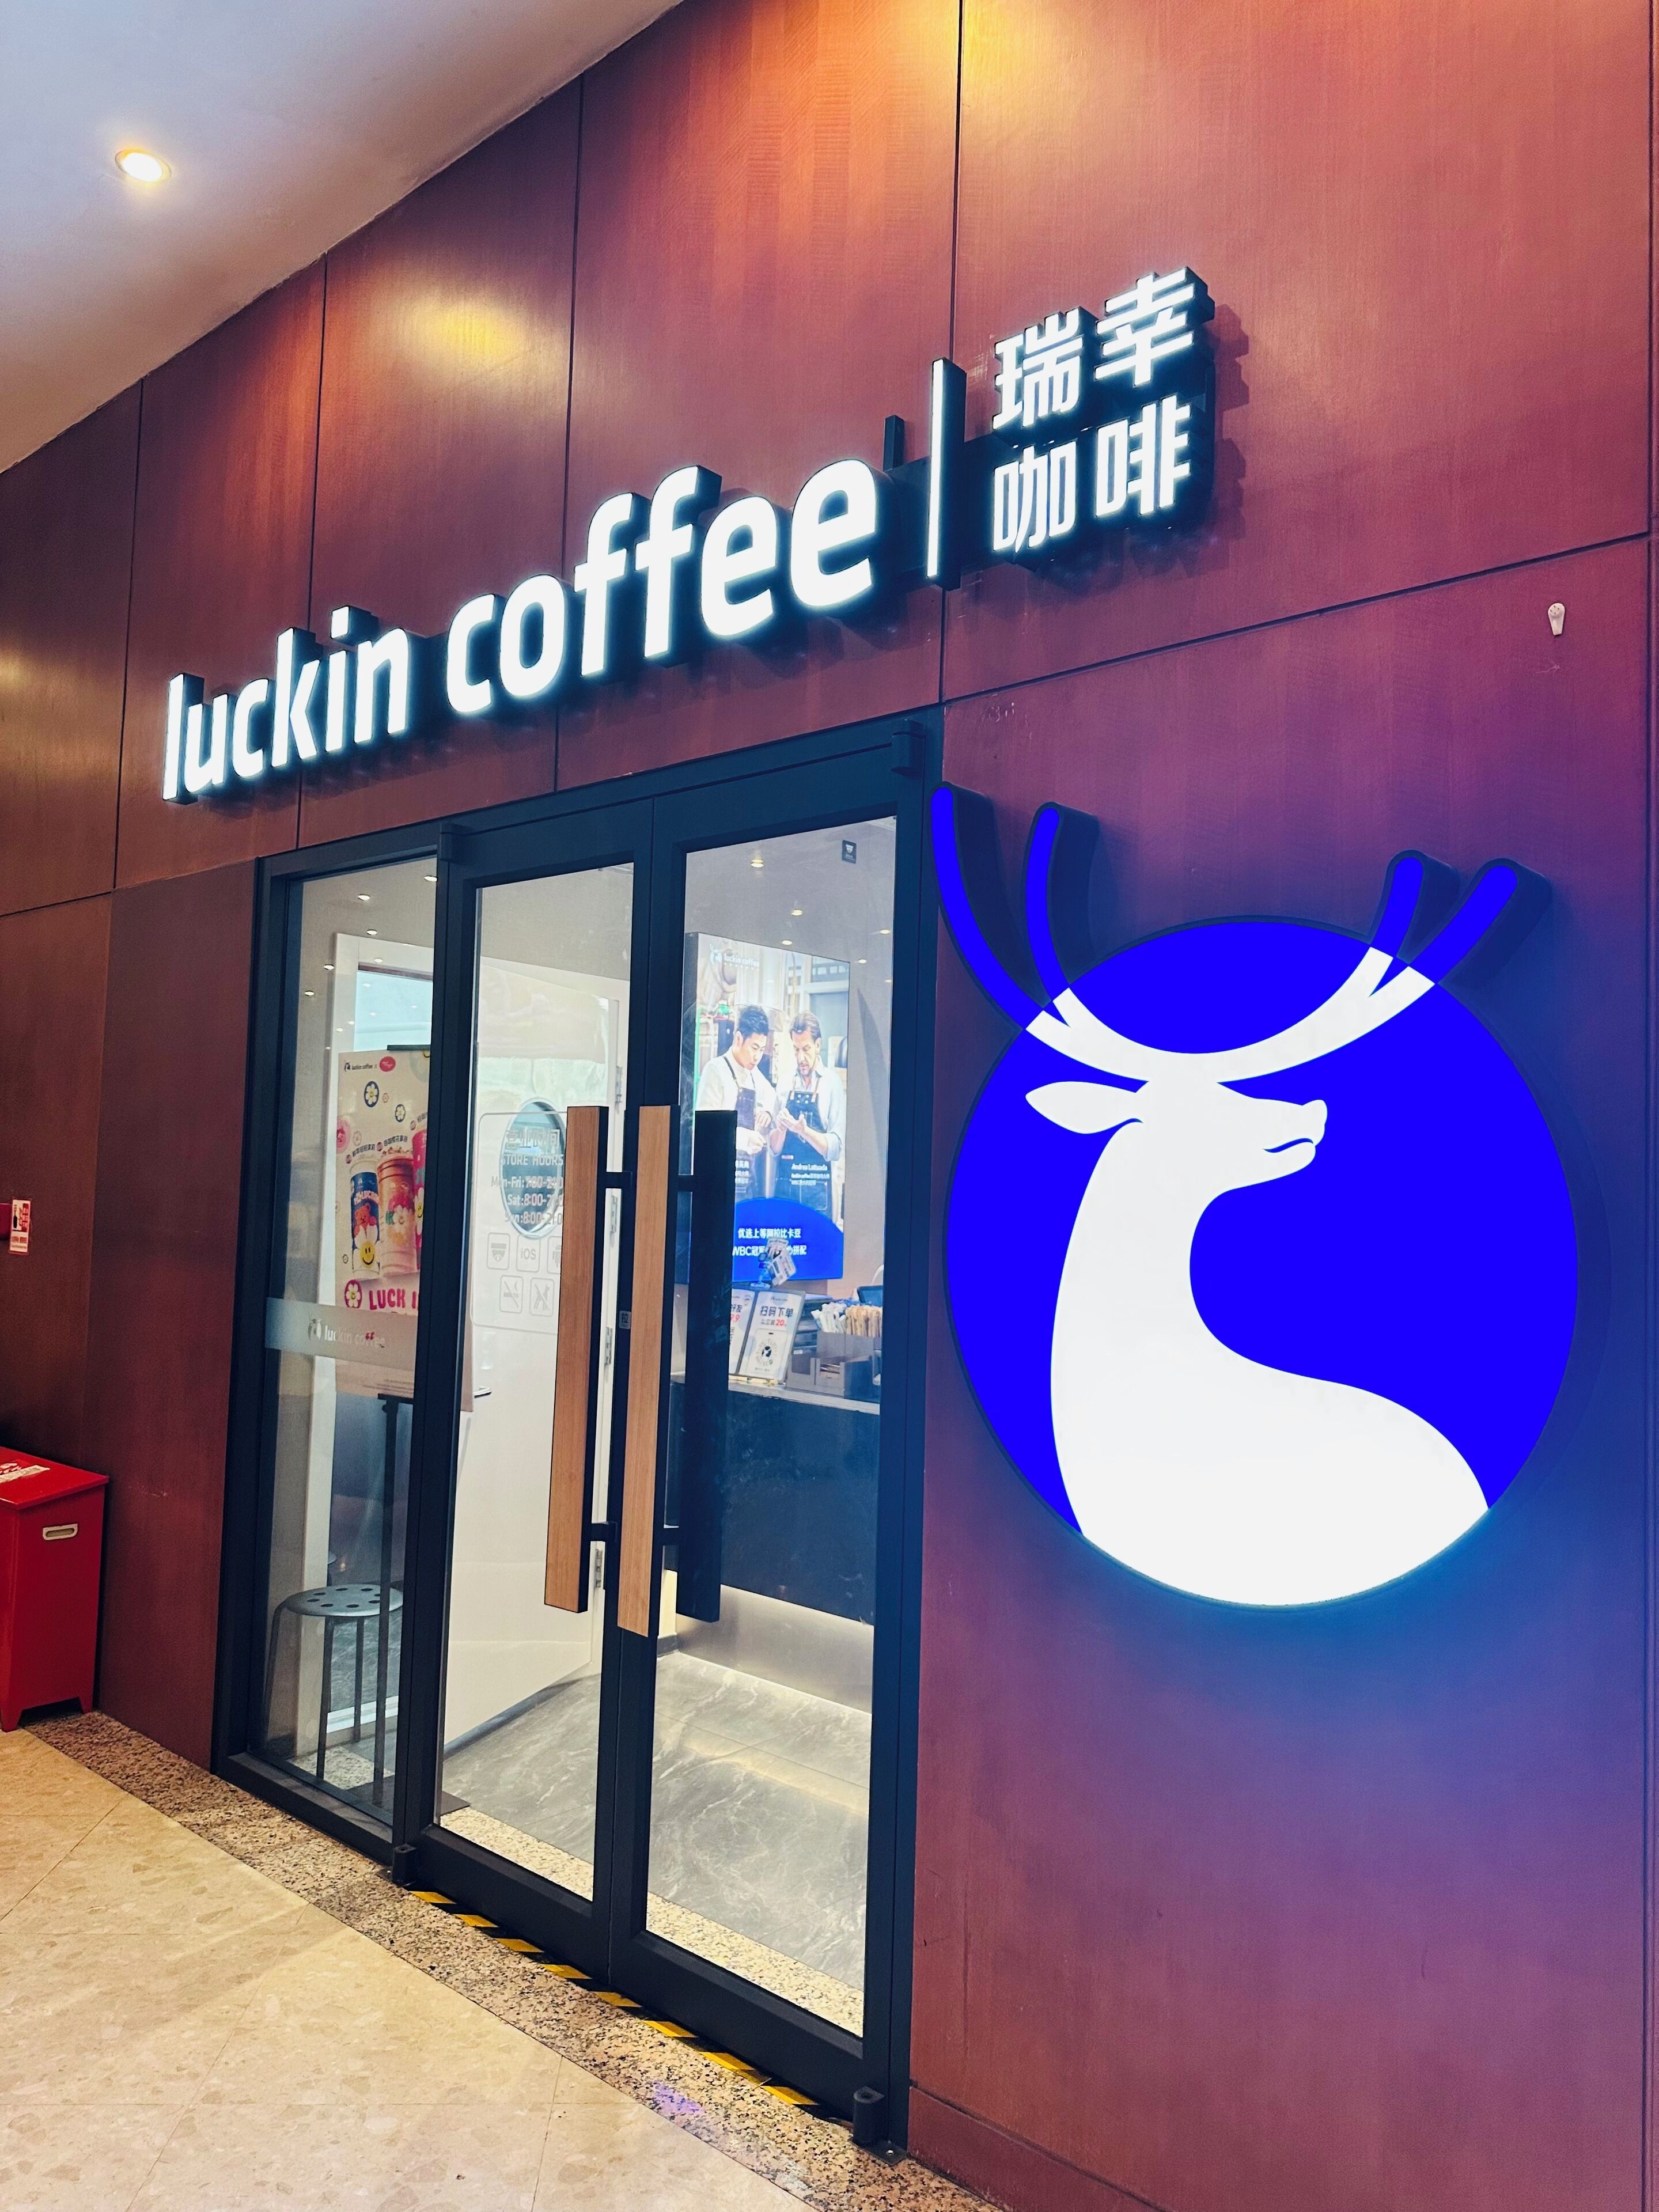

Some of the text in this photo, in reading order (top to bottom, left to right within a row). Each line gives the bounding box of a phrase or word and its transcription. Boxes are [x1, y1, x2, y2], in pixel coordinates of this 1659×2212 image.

[992, 267, 1194, 429] 瑞幸
[993, 395, 1191, 553] 咖啡
[162, 459, 877, 801] luckin coffee
[501, 1153, 564, 1166] STORE HOURS
[738, 1228, 801, 1238] 优选上等阿拉比卡豆
[521, 1248, 536, 1260] iOS
[369, 1288, 406, 1310] LUCK
[760, 1305, 794, 1318] 扫码下单
[324, 1325, 385, 1348] luckin coffee
